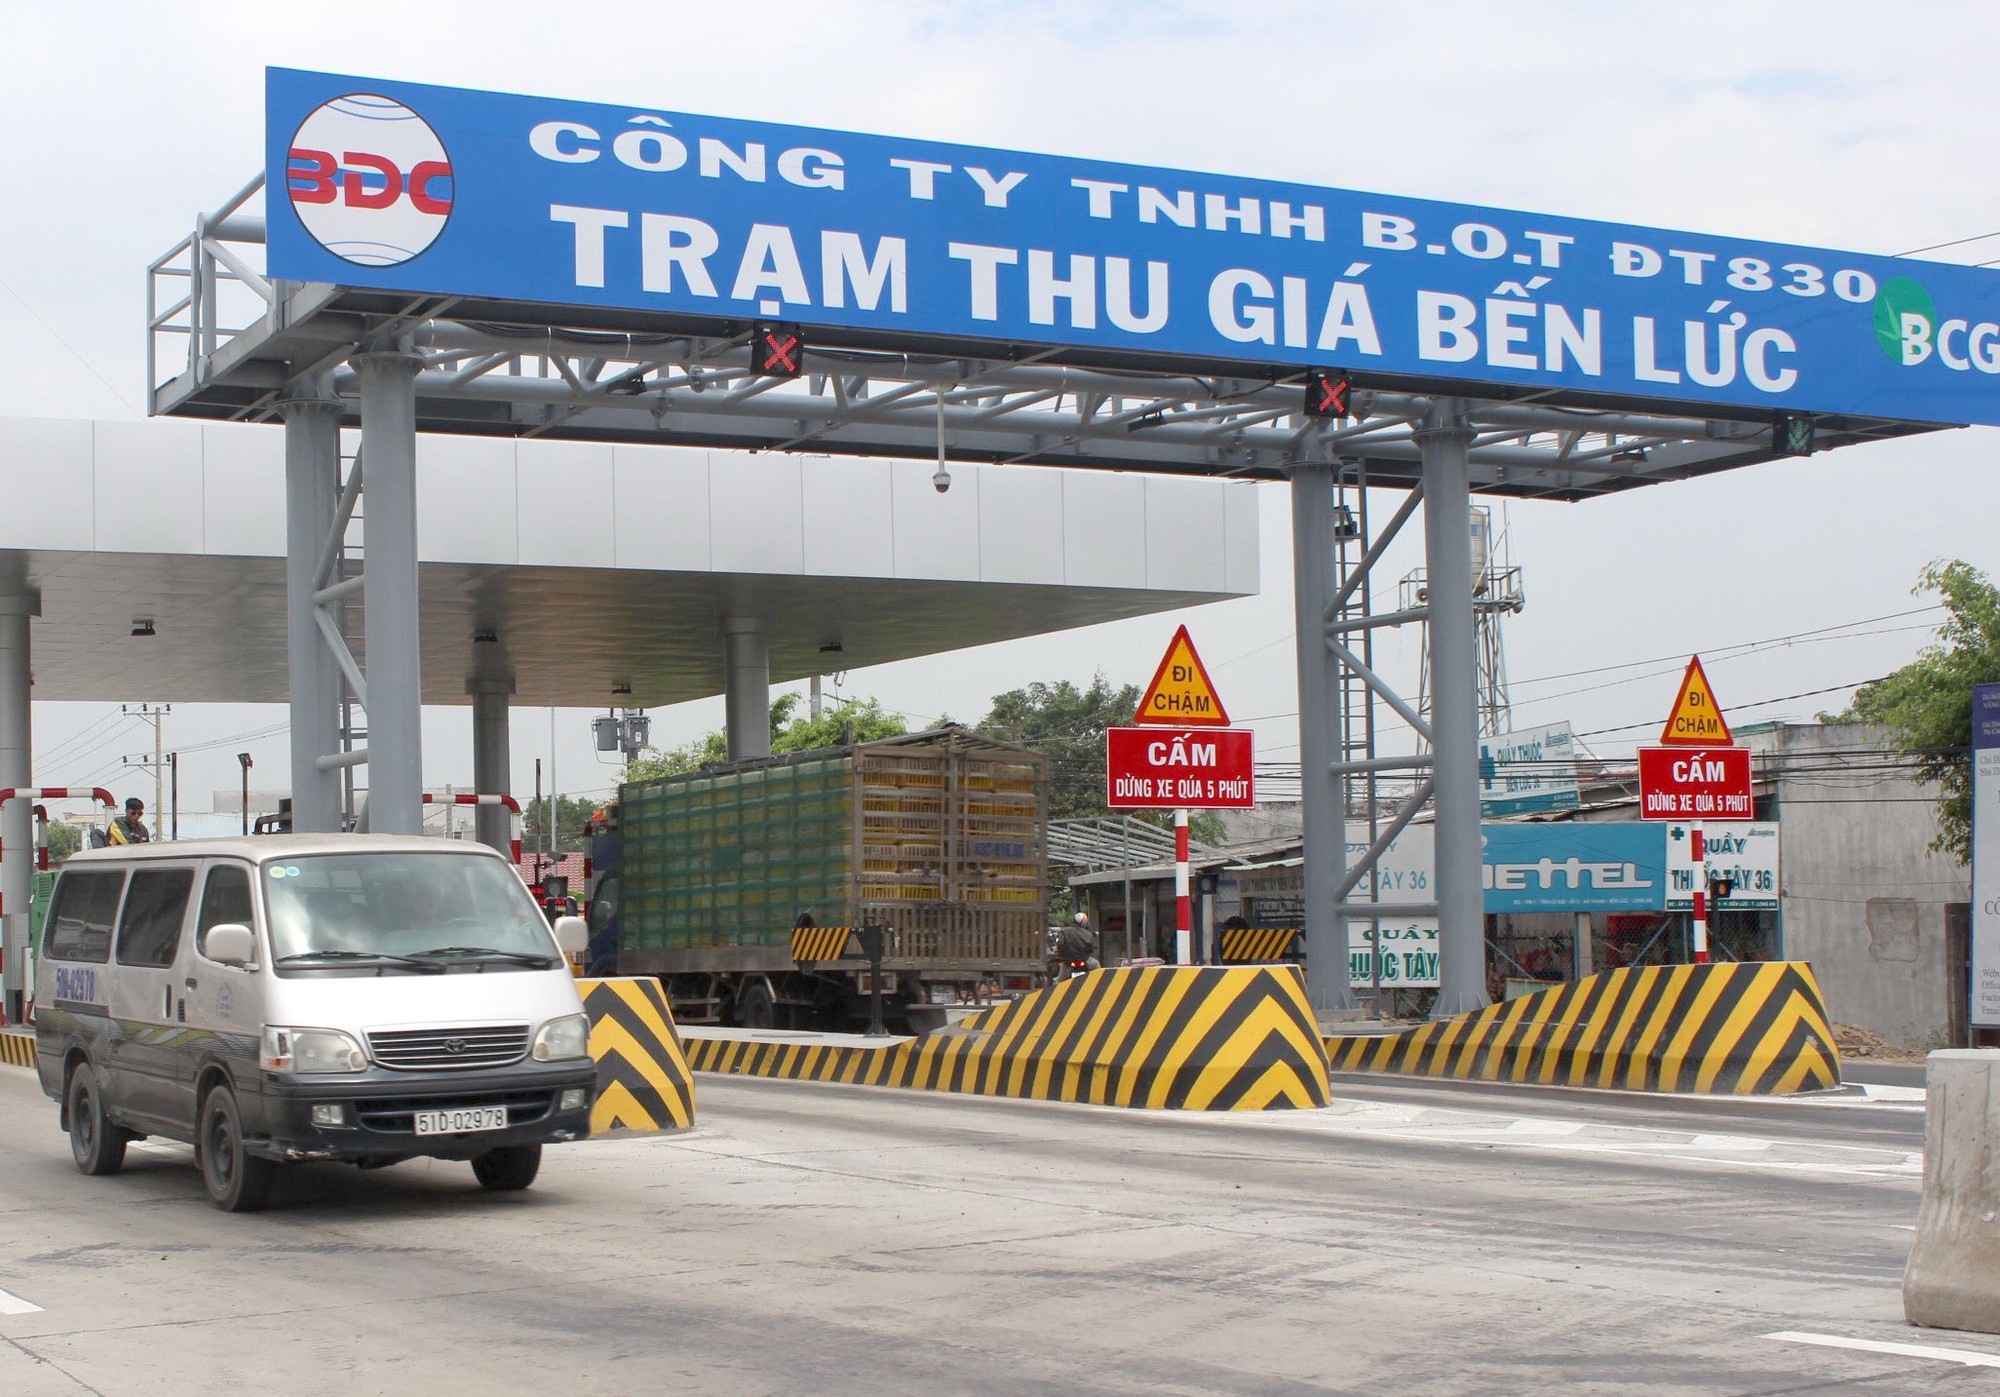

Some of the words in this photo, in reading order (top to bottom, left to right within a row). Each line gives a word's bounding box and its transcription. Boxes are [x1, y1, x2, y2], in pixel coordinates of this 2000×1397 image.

[529, 114, 845, 191] CÔNG
[890, 158, 1028, 208] TY
[1071, 178, 1326, 242] TNHH
[1361, 212, 1574, 268] B.O.T
[1609, 242, 1877, 303] ĐT830
[549, 204, 907, 317] TRẠM
[948, 241, 1169, 334] THU
[1208, 262, 1384, 357] GIÁ
[1417, 276, 1601, 377] BẾN
[1633, 301, 1798, 394] LỨC
[1900, 312, 2000, 374] BCG
[1172, 665, 1193, 683] ĐI
[1153, 690, 1210, 715] CHẬM
[1689, 691, 1705, 708] ĐI
[1675, 714, 1718, 736] CHẬM
[1148, 733, 1217, 767] CẤM
[1672, 752, 1725, 783] CẤM
[1115, 773, 1152, 798] DỪNG
[1157, 779, 1174, 798] XE
[1207, 780, 1215, 798] 5
[1219, 775, 1249, 799] PHÚT
[1647, 788, 1677, 812] DỪNG
[1679, 794, 1693, 812] XE
[1717, 794, 1723, 812] 5
[1725, 790, 1749, 812] PHÚT
[1408, 870, 1428, 891] 36
[1754, 869, 1773, 891] 36
[1403, 947, 1440, 981] TÂY
